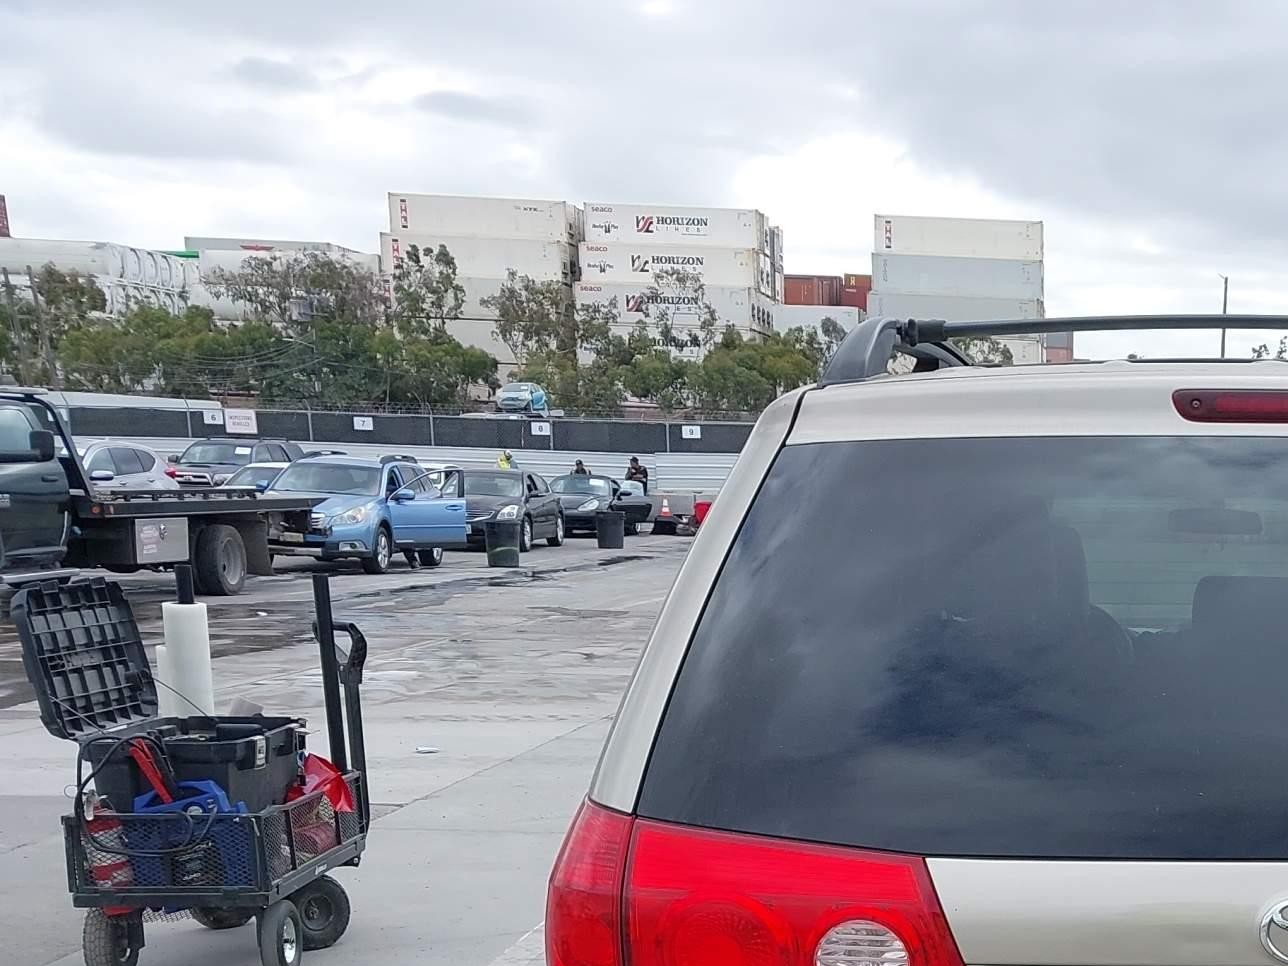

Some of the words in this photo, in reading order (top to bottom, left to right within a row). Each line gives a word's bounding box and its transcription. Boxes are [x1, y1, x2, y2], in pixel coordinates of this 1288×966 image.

[656, 216, 708, 226] HORIZON
[652, 256, 704, 266] HORIZON
[646, 295, 699, 305] HORIZON
